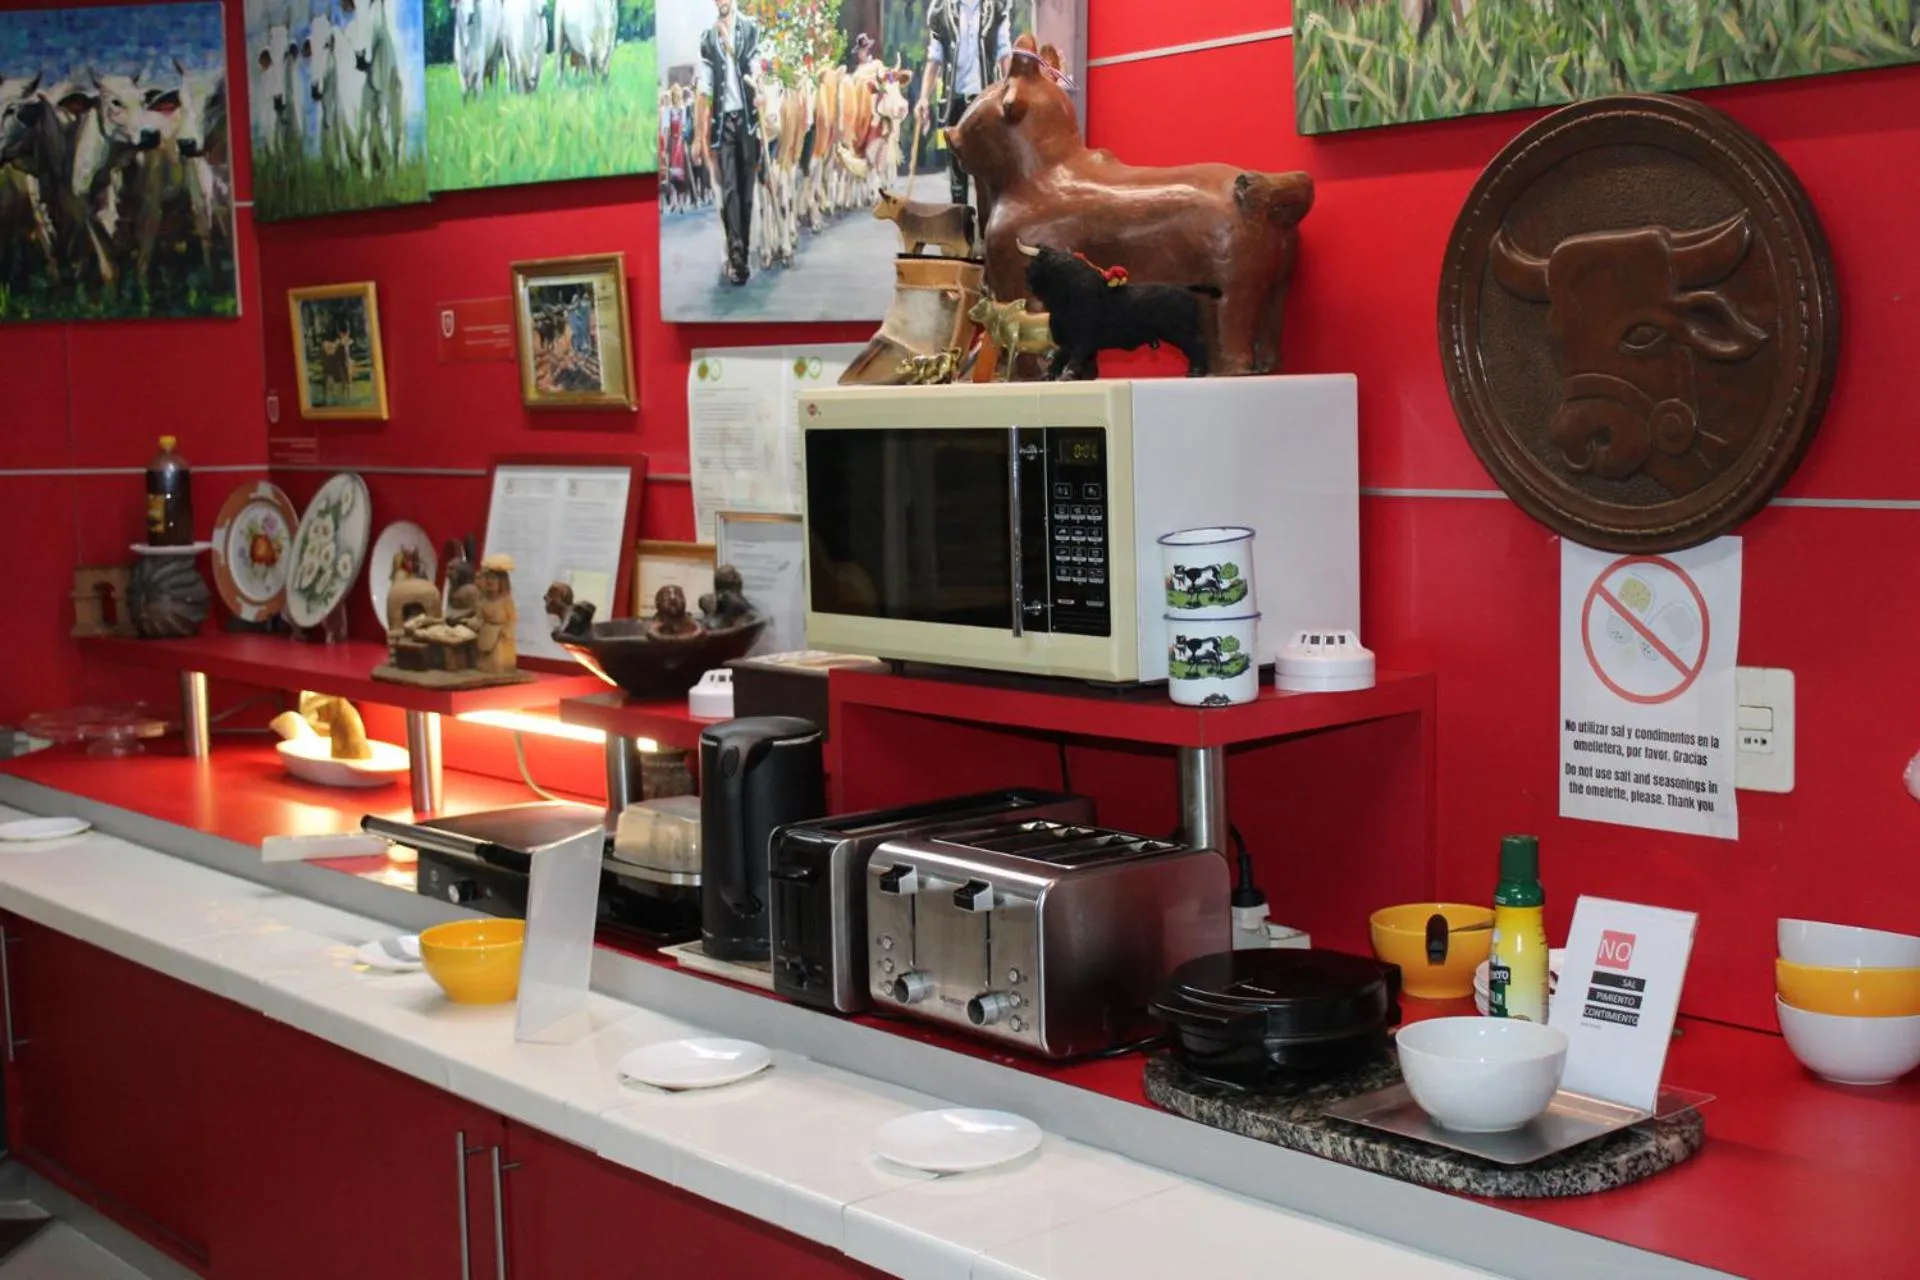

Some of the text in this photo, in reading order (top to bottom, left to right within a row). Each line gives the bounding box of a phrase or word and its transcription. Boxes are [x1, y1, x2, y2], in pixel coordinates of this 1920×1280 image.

[1565, 719, 1720, 749] No utilizar sal y condimentos en la
[1626, 746, 1643, 759] por
[1673, 749, 1708, 766] Gracias
[1565, 762, 1718, 794] Do not use salt and seasonings in
[1569, 781, 1715, 812] the omelette, please. Thank you
[1598, 939, 1632, 962] NO
[1621, 978, 1637, 989] SAL
[1596, 991, 1636, 1006] PIMIENTO
